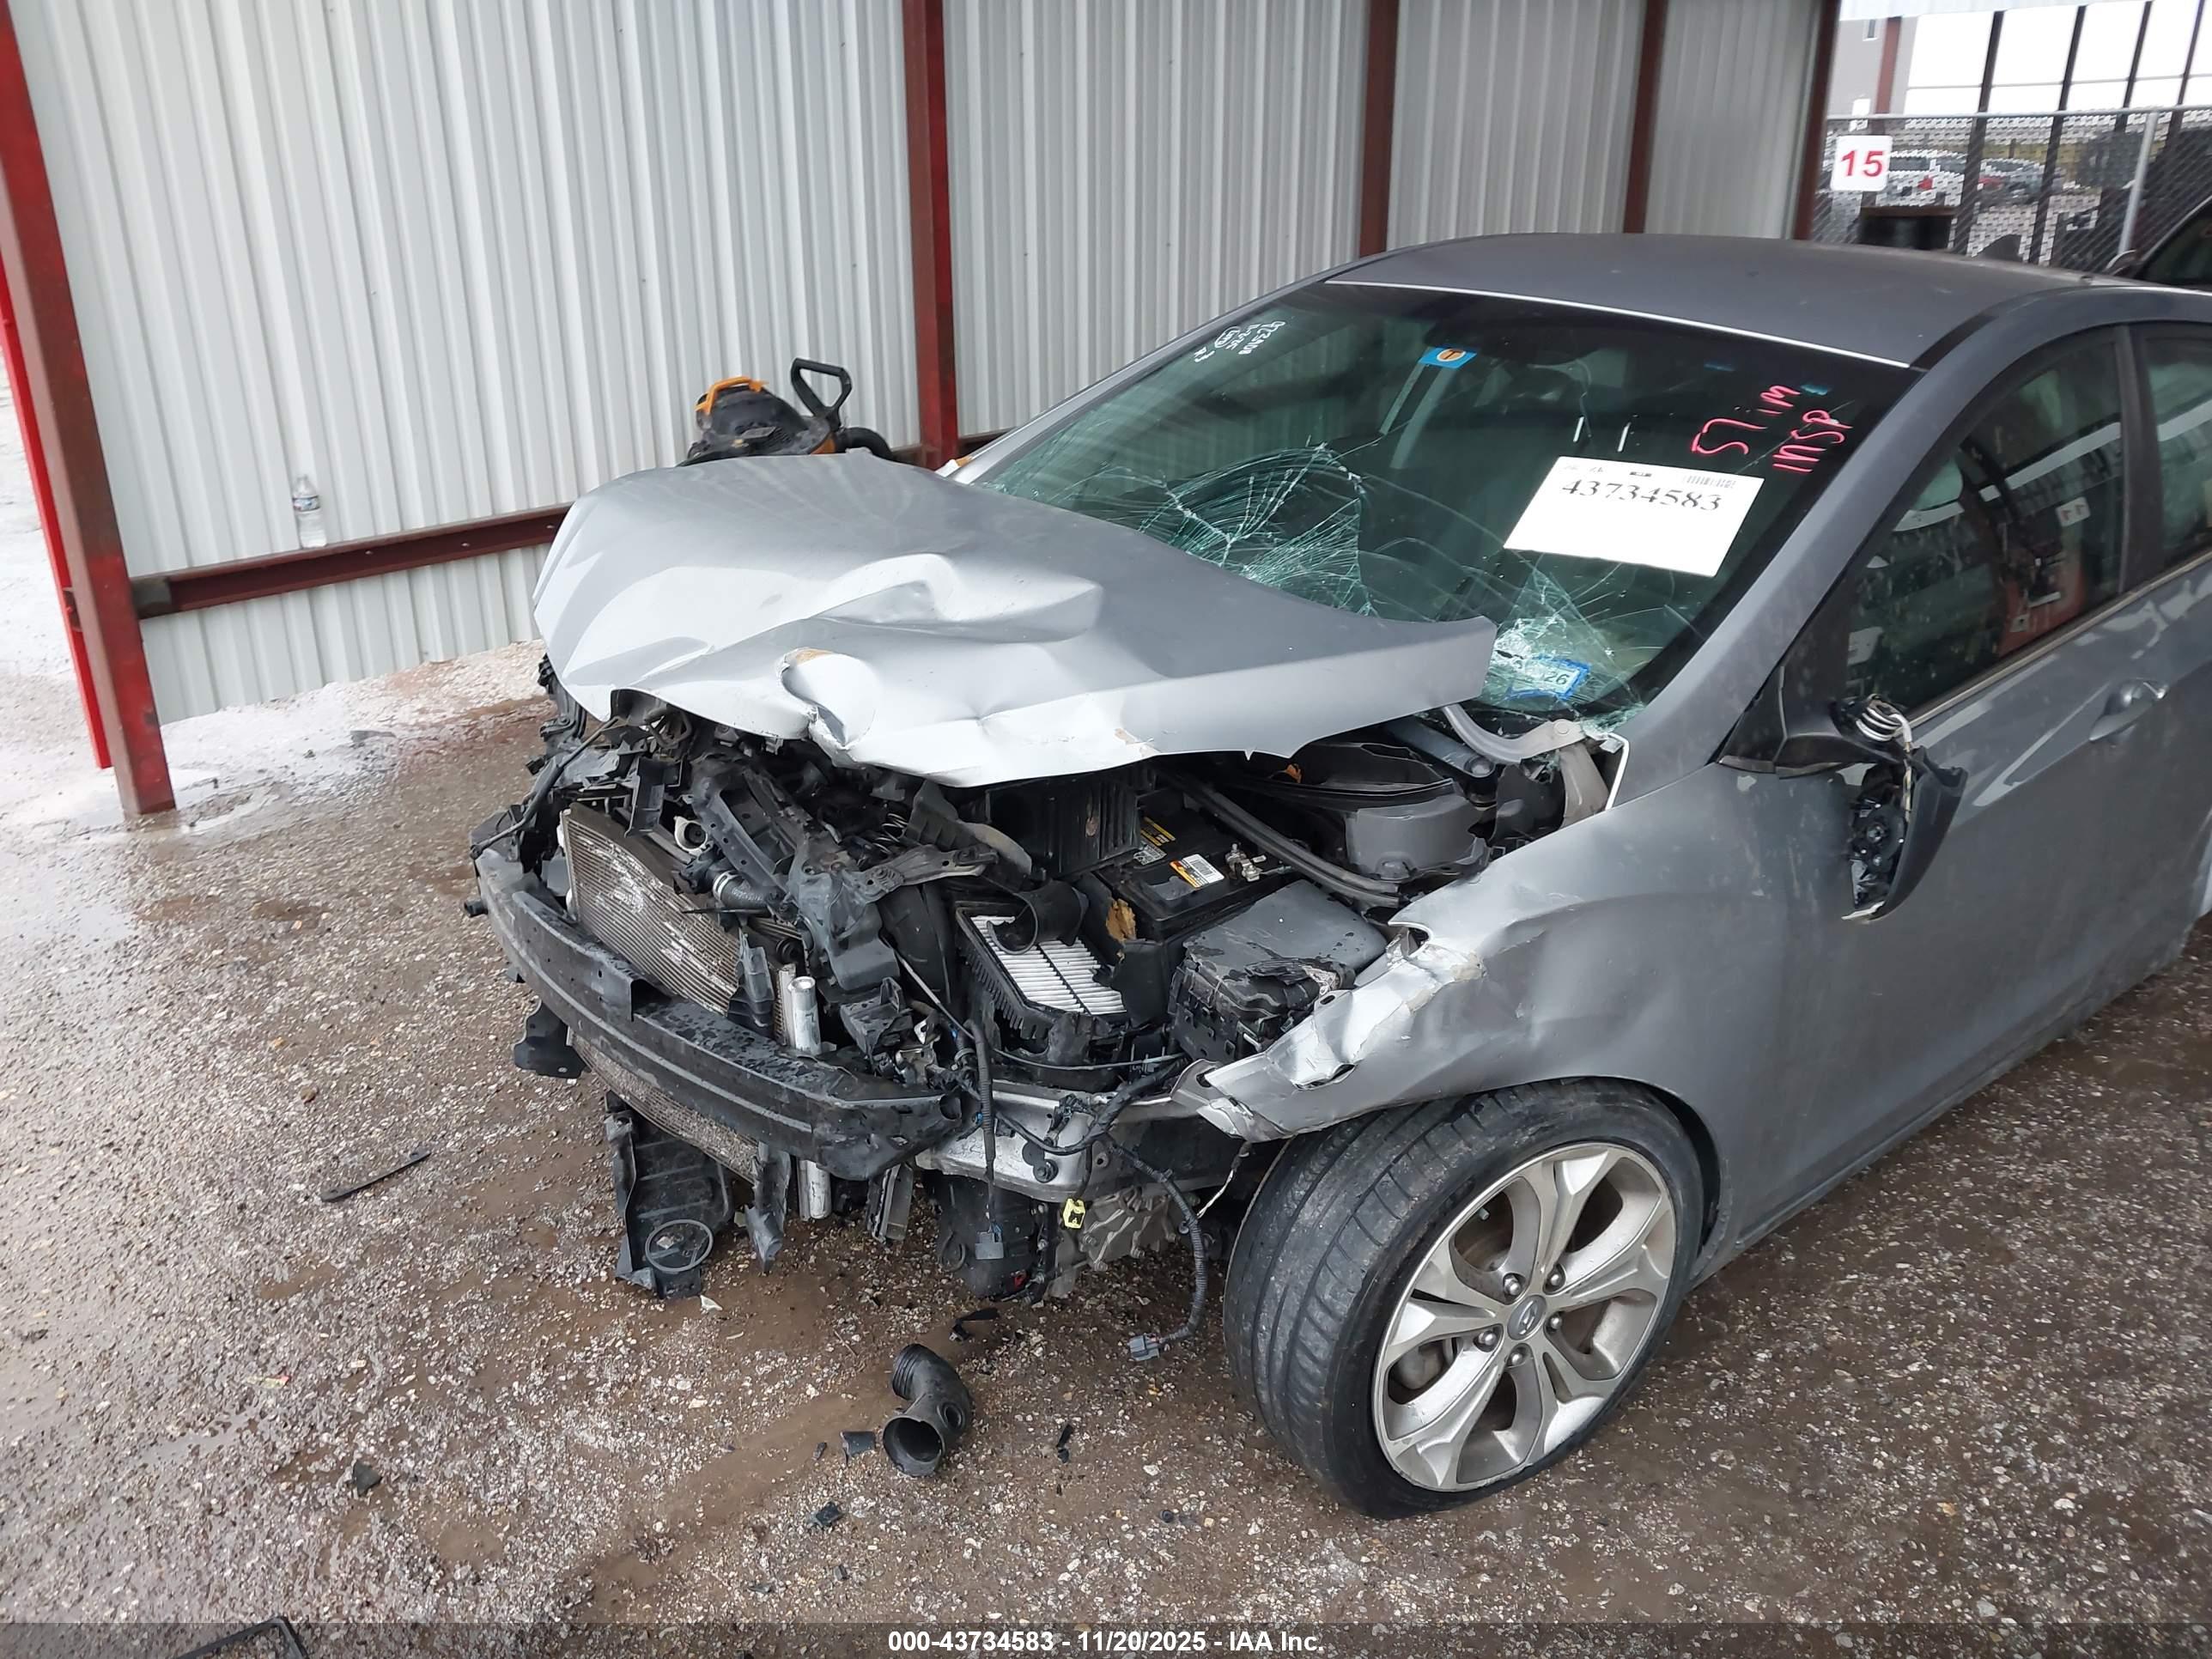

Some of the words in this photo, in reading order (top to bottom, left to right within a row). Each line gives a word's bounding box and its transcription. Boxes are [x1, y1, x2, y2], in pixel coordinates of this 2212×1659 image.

[1841, 149, 1883, 177] 15
[1562, 478, 1722, 512] 43734583
[1544, 670, 1570, 685] 26
